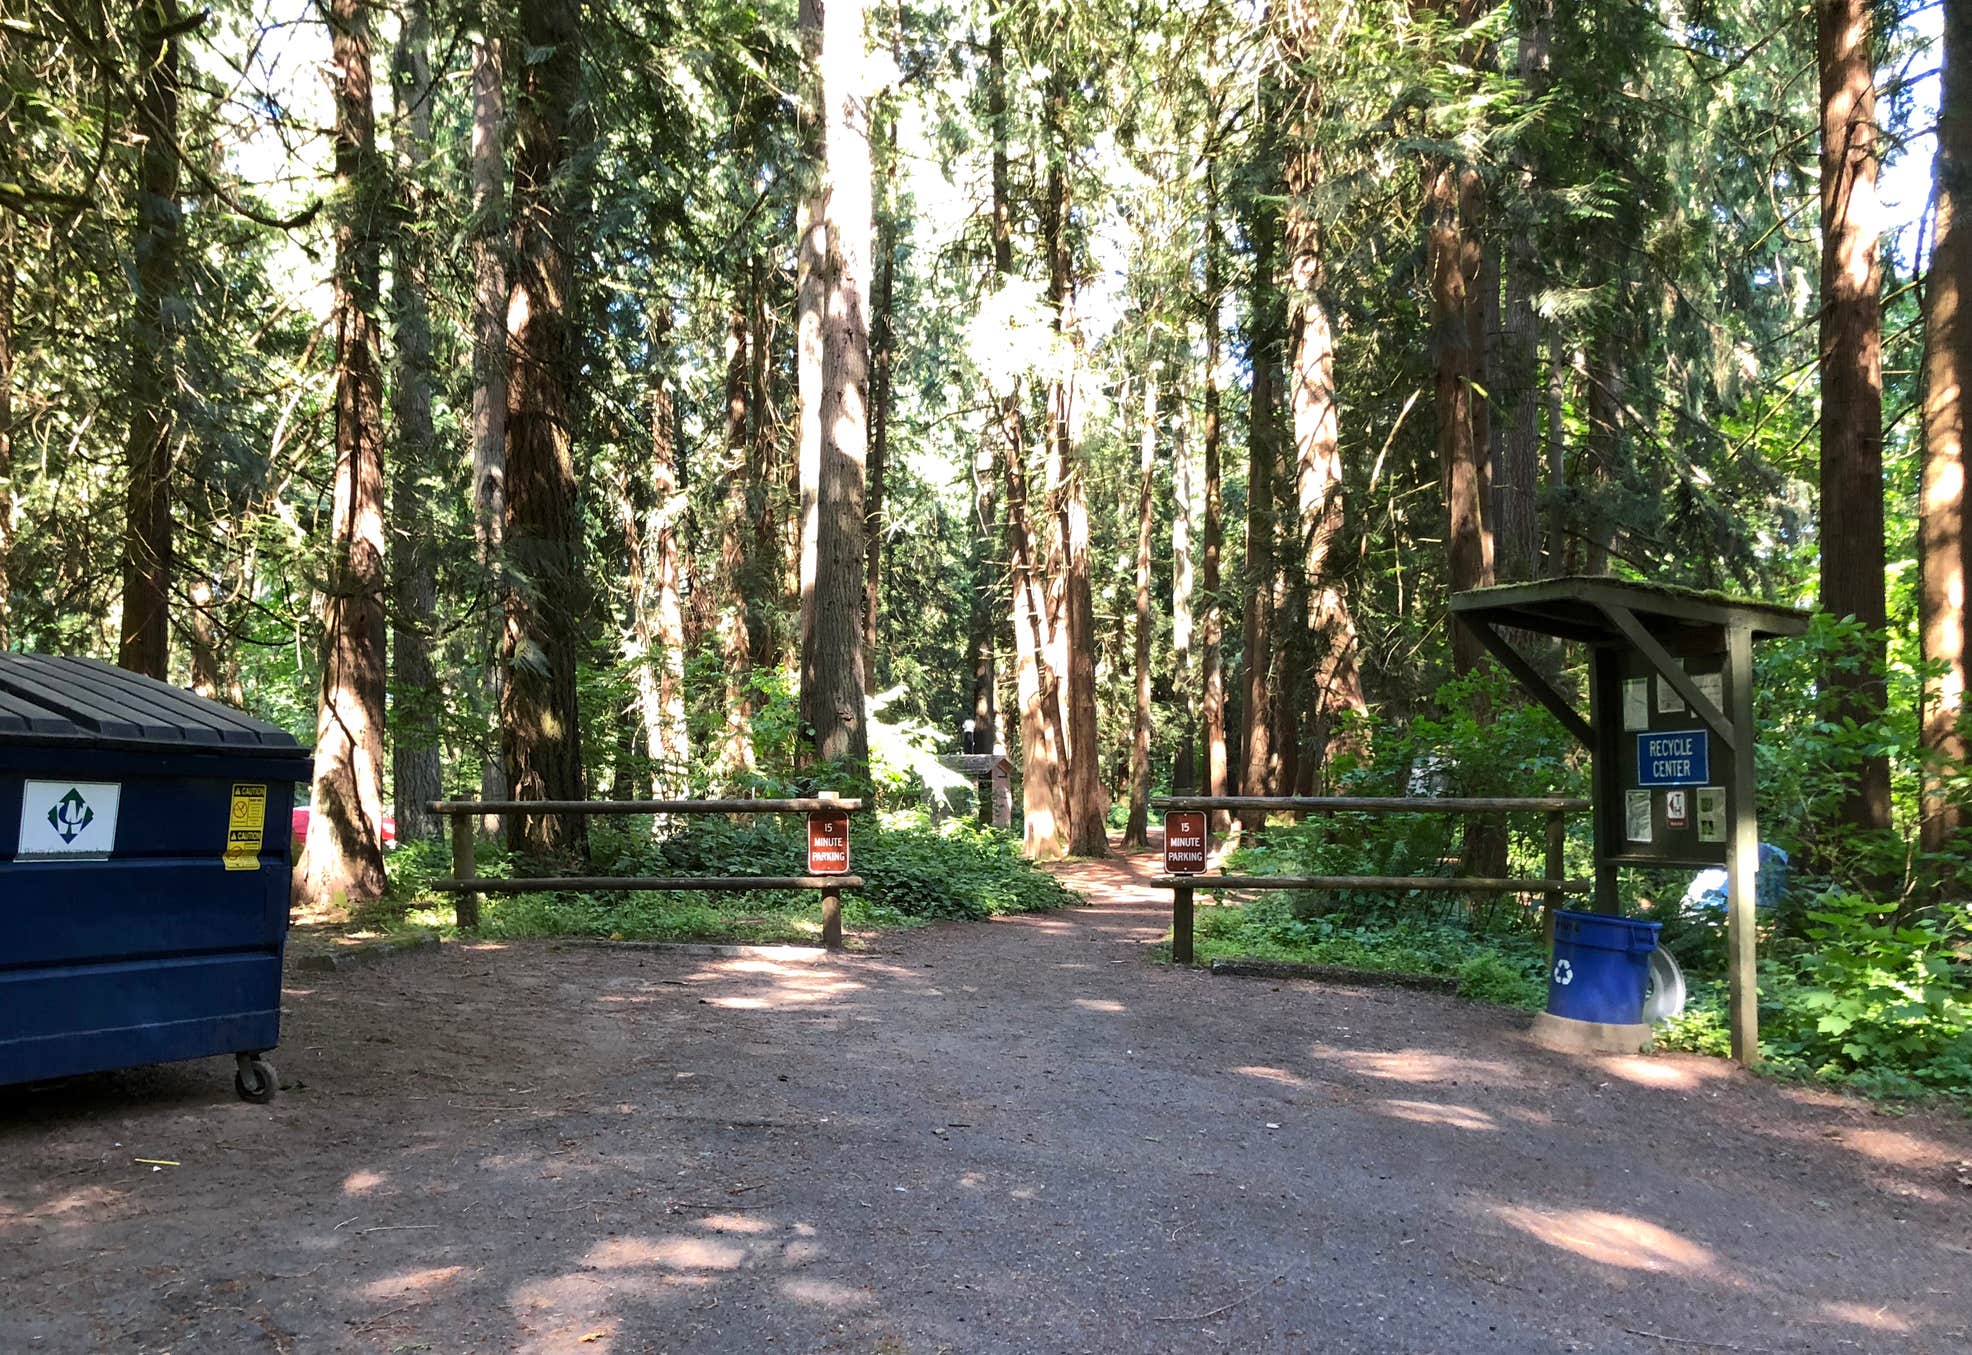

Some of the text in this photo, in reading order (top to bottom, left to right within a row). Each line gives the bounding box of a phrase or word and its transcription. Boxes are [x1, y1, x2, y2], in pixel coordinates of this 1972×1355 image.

[1649, 738, 1693, 757] RECYCLE
[1652, 760, 1691, 778] CENTER
[241, 787, 265, 796] CAUTION
[824, 823, 833, 832] 15
[1181, 823, 1190, 832] 15
[237, 831, 262, 840] CAUTION
[814, 837, 843, 847] MINUTE
[1170, 837, 1201, 847] MINUTE
[812, 852, 845, 861] PARKING
[1168, 852, 1203, 861] PARKING
